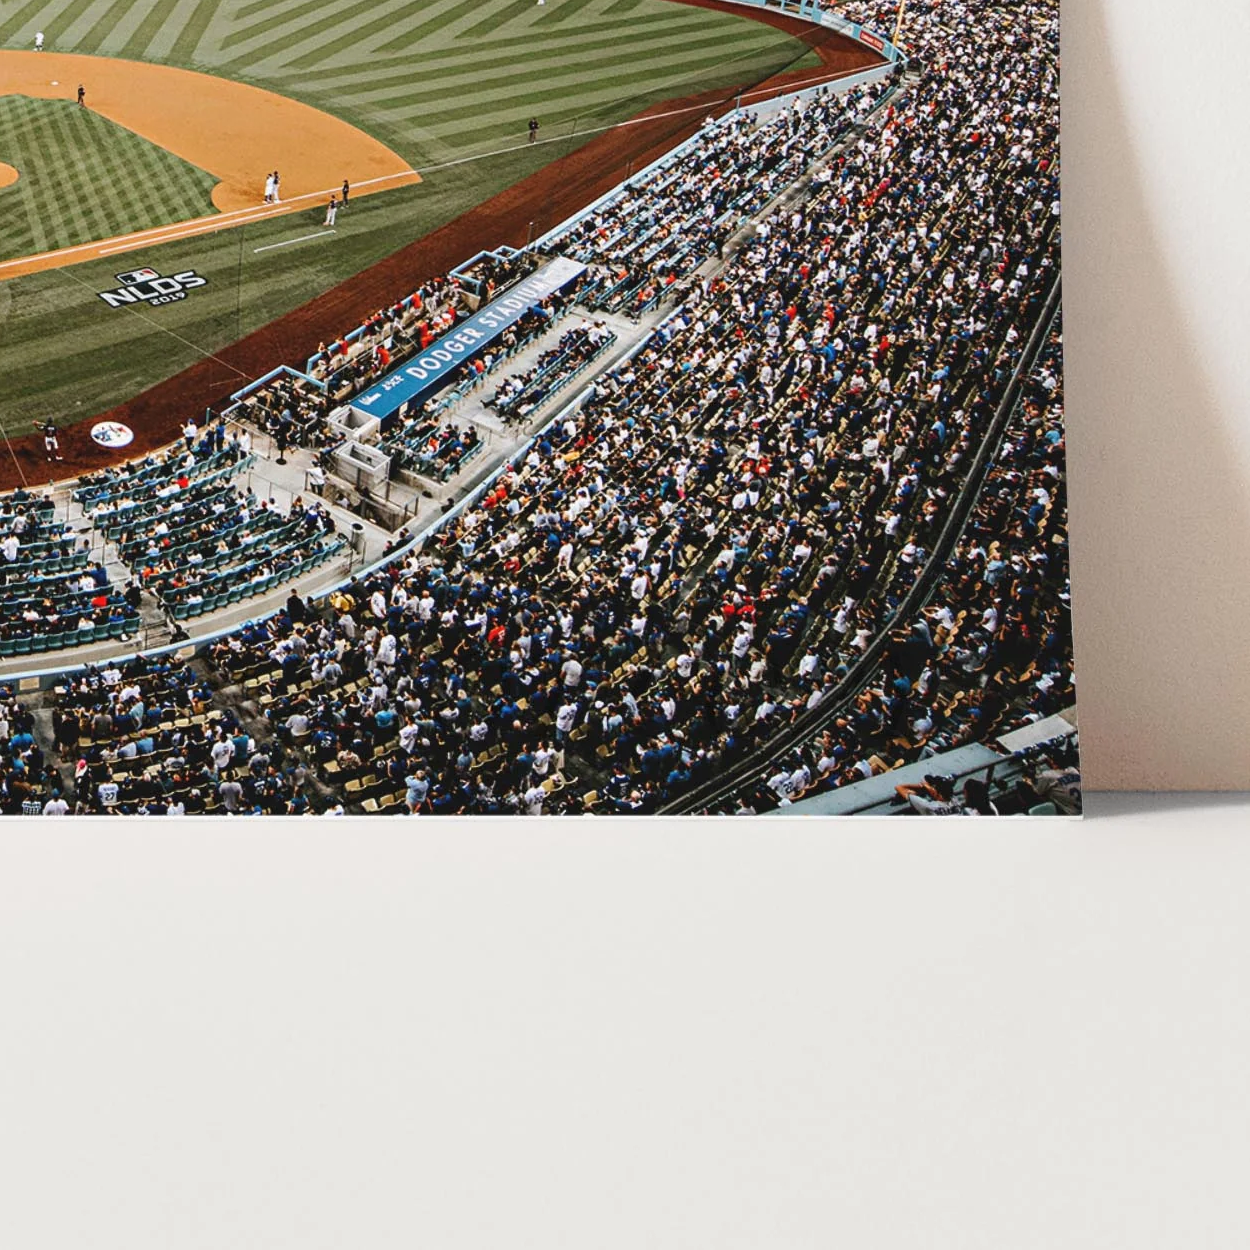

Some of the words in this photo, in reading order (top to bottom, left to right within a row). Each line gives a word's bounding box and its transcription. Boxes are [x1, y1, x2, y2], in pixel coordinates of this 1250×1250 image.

[98, 270, 208, 308] NLDS
[406, 327, 486, 381] DODGER
[478, 279, 550, 329] STADIUM
